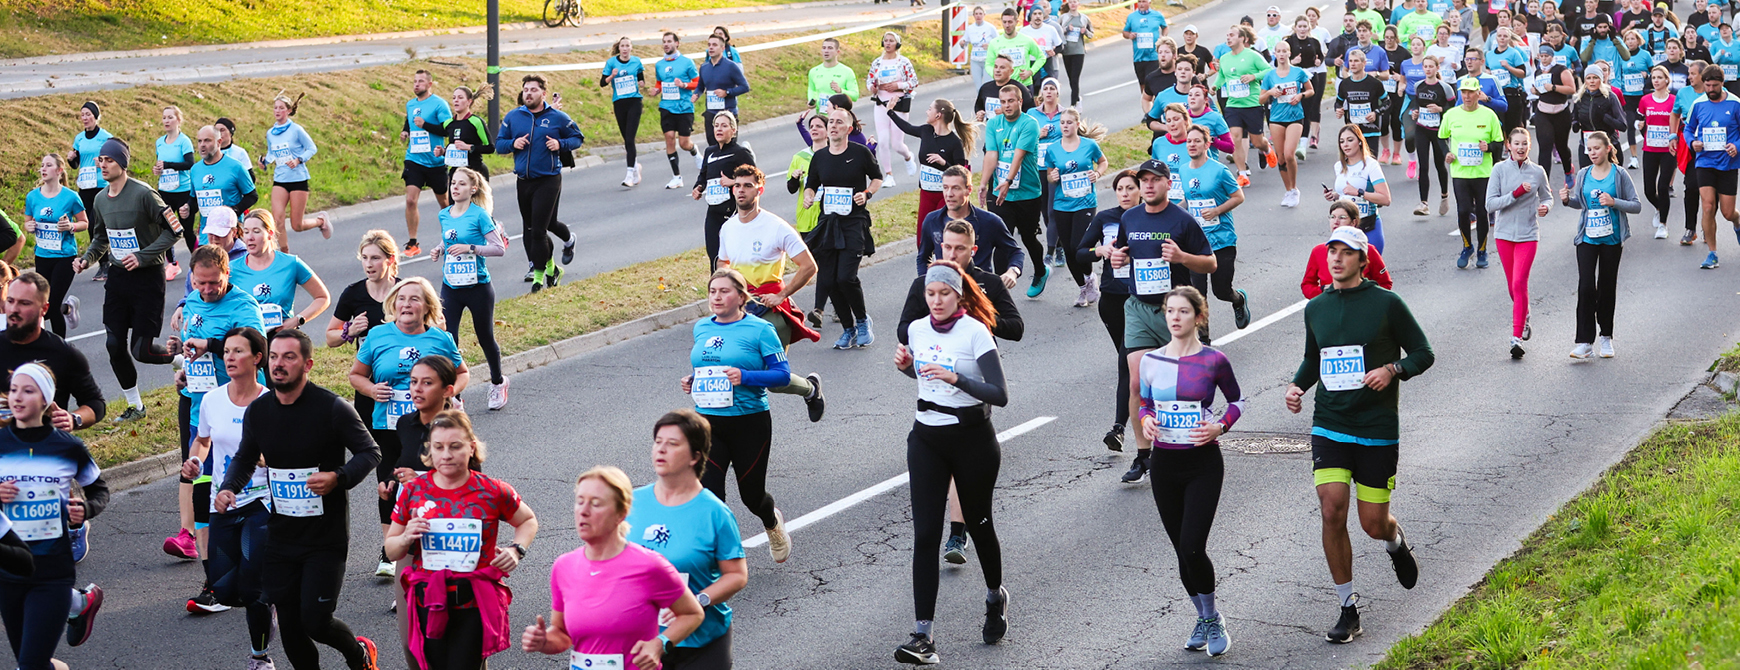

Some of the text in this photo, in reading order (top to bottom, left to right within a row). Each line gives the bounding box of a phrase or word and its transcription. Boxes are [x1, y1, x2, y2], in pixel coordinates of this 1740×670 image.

[454, 264, 475, 273] 19513
[1144, 268, 1168, 280] 15808
[191, 364, 212, 376] 14347
[703, 380, 729, 391] 16460
[12, 503, 60, 518] C 16099
[428, 536, 478, 552] E 14417
